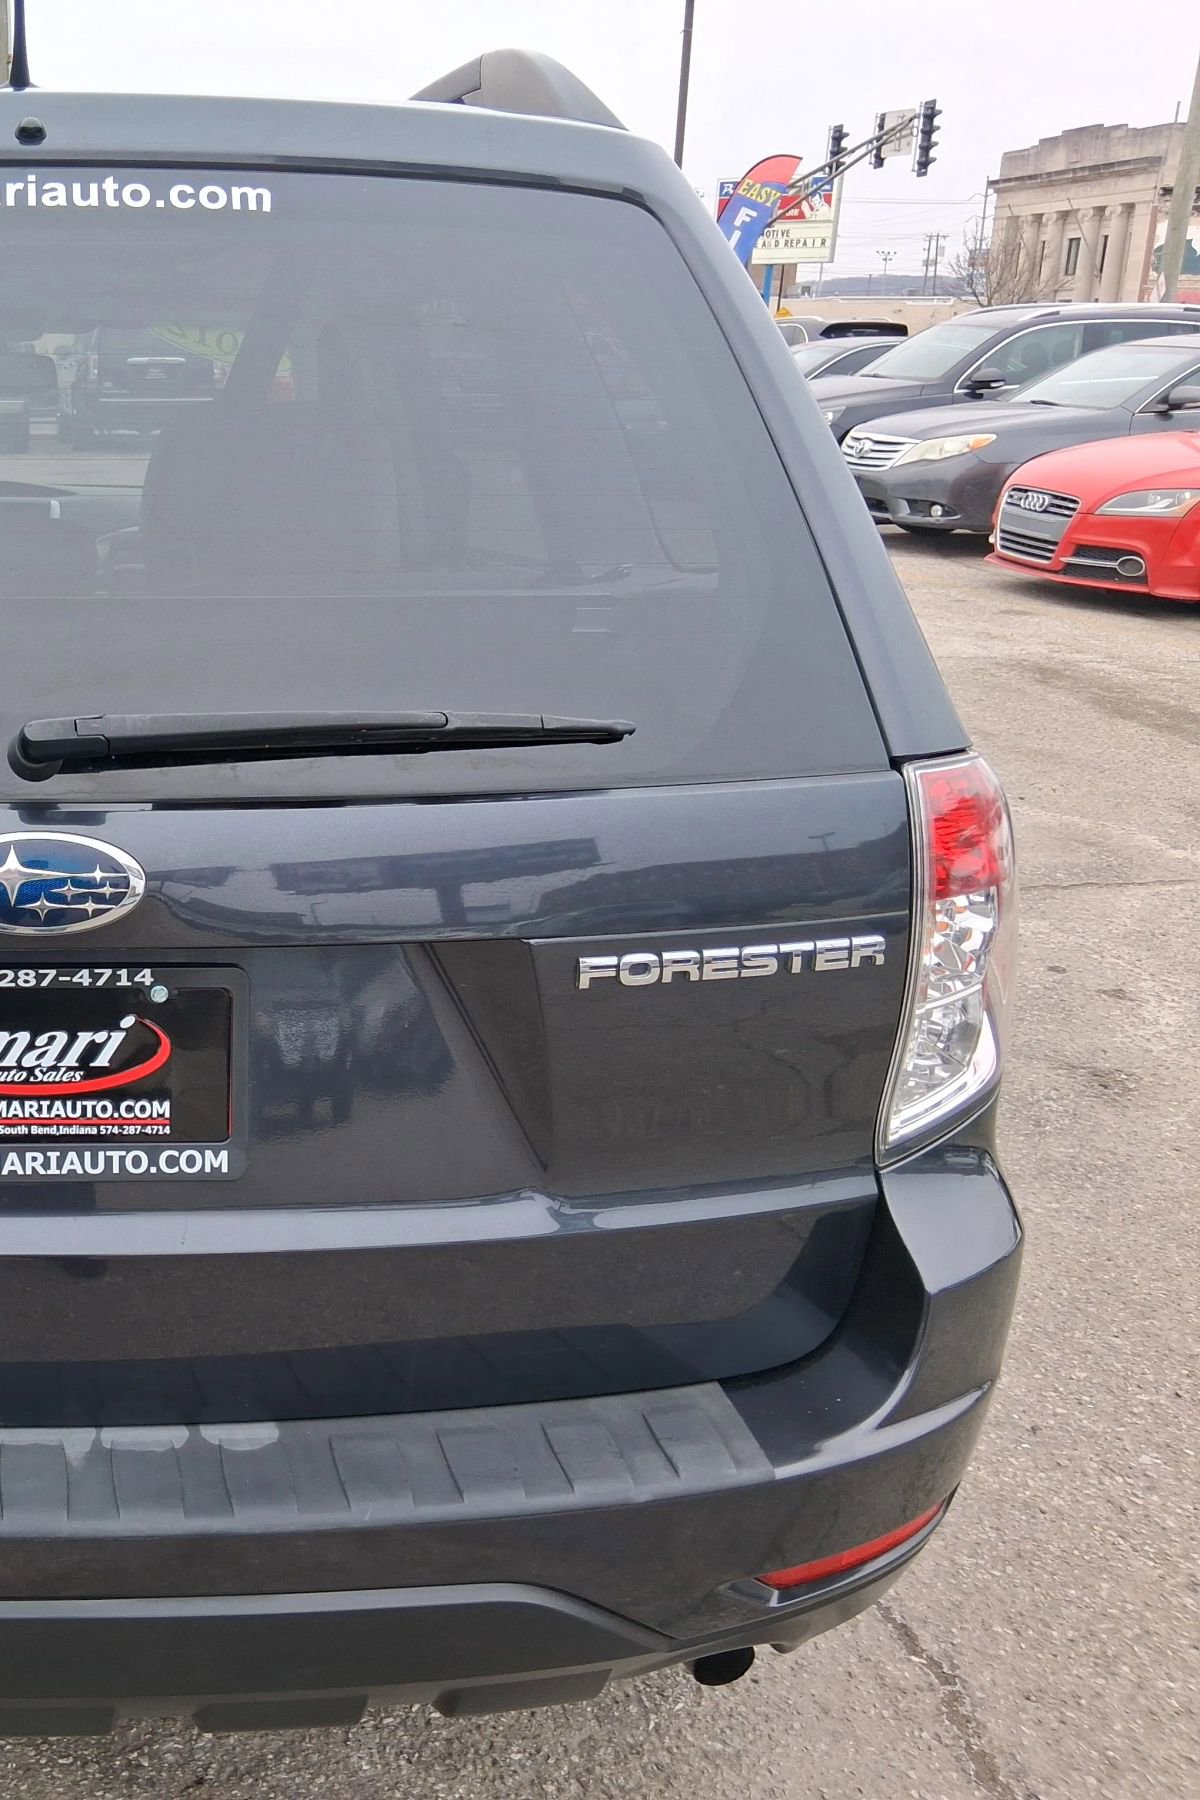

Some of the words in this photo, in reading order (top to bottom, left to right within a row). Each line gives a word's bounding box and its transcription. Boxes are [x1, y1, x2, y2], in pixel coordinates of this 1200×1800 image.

[738, 178, 782, 207] EASY
[783, 238, 827, 248] REPAIR
[576, 934, 887, 990] FORESTER
[29, 1067, 84, 1082] Sales
[99, 1125, 171, 1135] 574-287-4714
